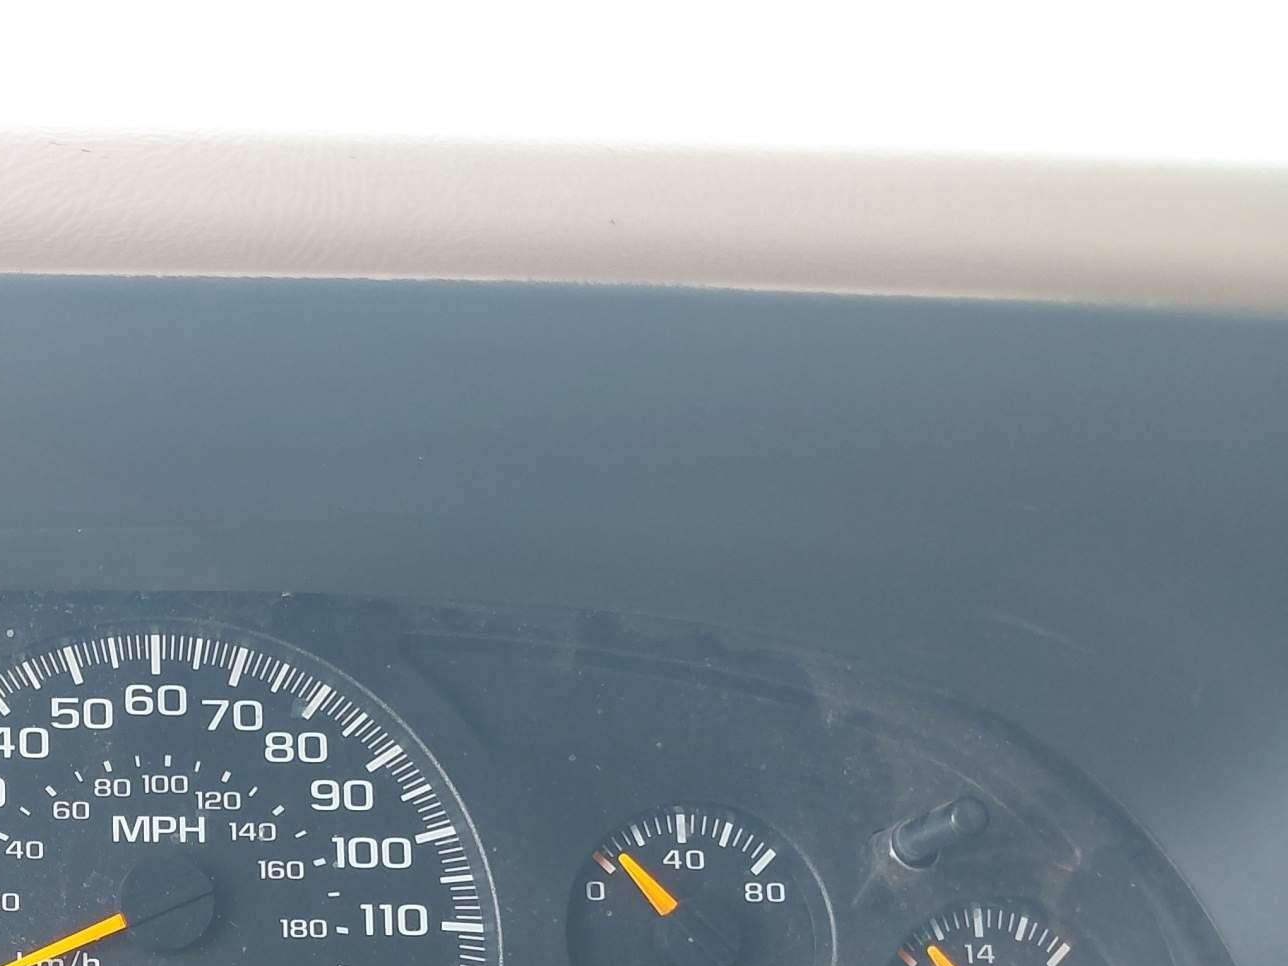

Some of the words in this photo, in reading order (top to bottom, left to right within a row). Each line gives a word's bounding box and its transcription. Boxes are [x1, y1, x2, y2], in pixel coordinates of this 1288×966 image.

[124, 684, 187, 716] 60
[50, 697, 113, 730] 50
[201, 699, 263, 731] 70
[264, 732, 328, 763] 80
[93, 778, 130, 798] 80
[142, 774, 188, 794] 100
[195, 791, 241, 810] 120
[310, 779, 373, 811] 90
[52, 801, 90, 820] 60
[112, 815, 206, 843] MPH
[229, 822, 276, 841] 140
[5, 841, 44, 860] 40
[331, 836, 412, 869] 100
[663, 850, 704, 870] 40
[257, 860, 304, 880] 160
[585, 881, 605, 901] 0
[744, 882, 785, 902] 80
[279, 919, 327, 938] 180
[360, 903, 428, 936] 110
[964, 944, 995, 964] 14
